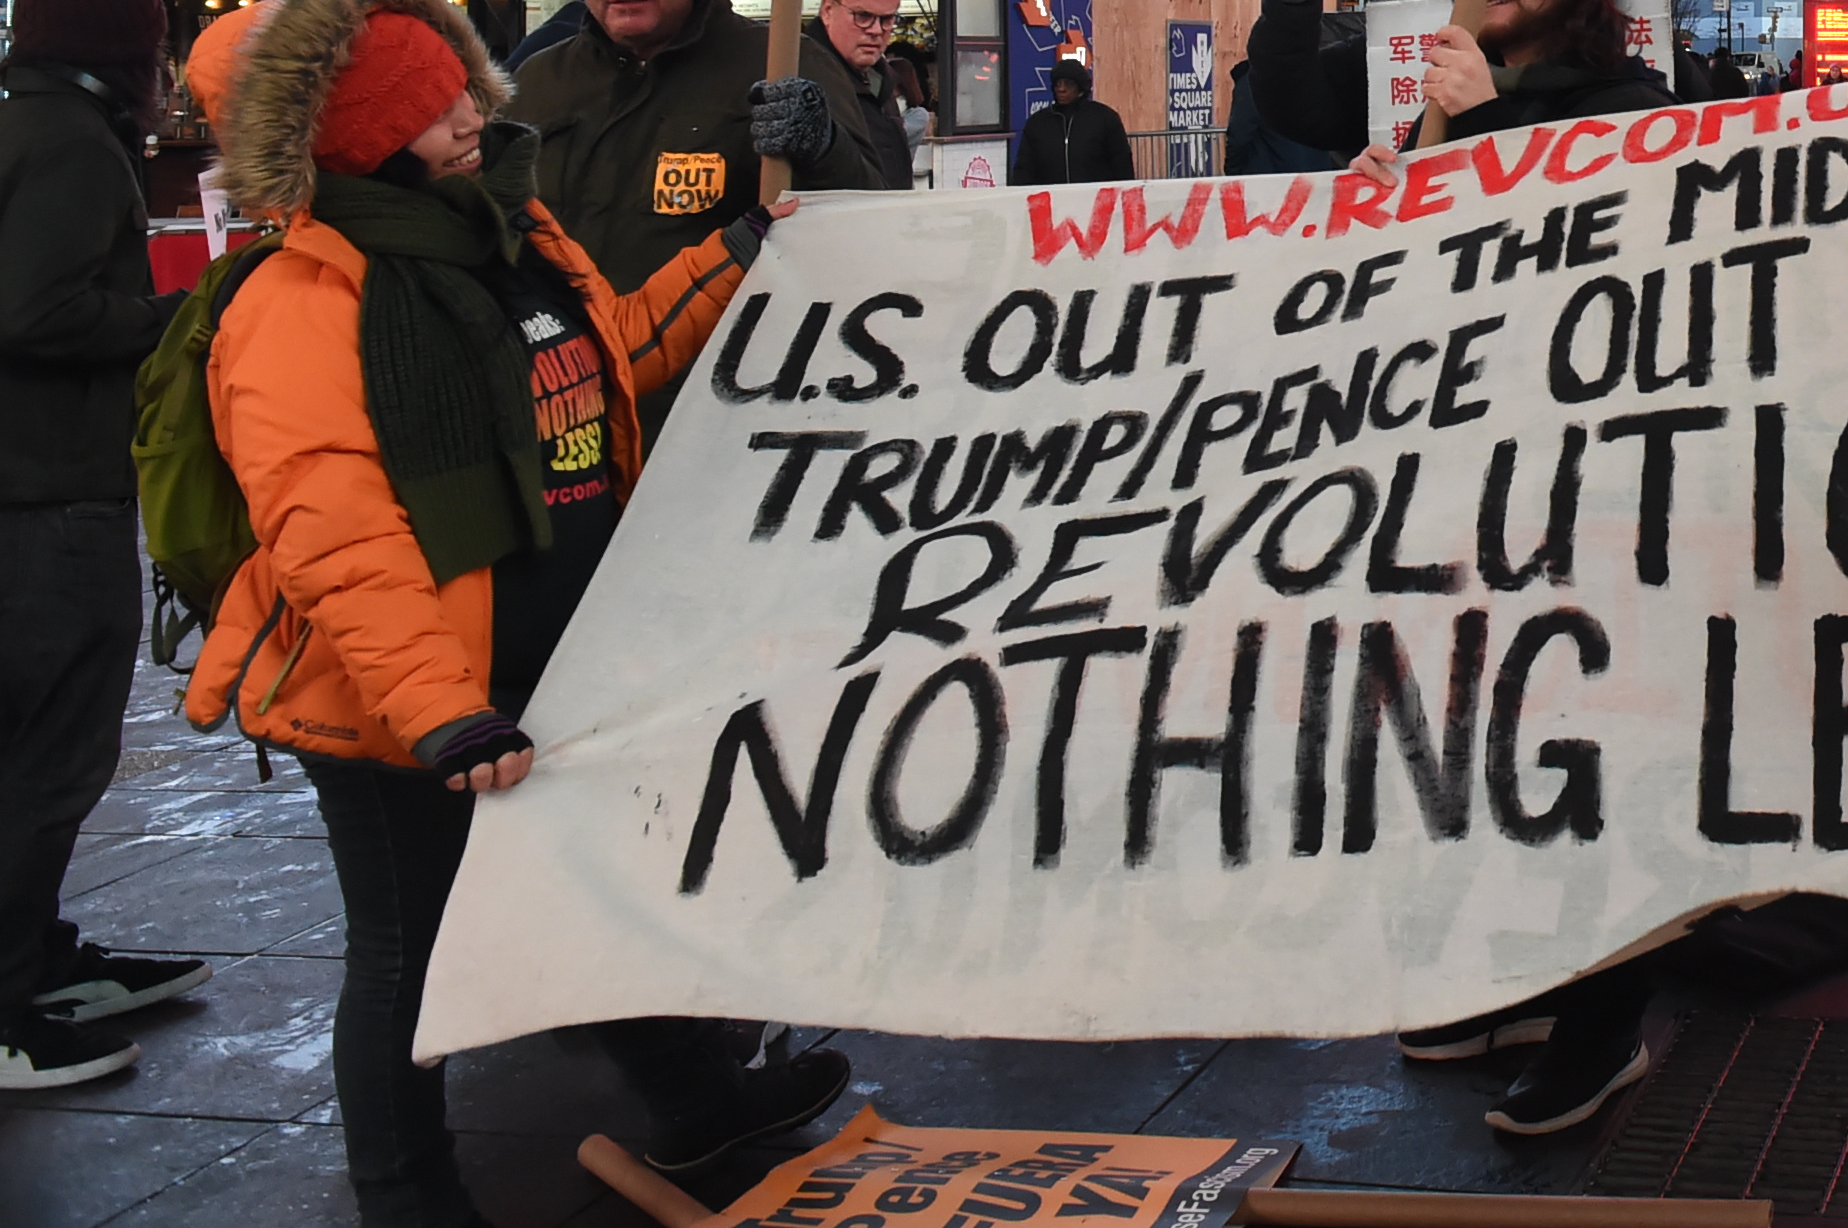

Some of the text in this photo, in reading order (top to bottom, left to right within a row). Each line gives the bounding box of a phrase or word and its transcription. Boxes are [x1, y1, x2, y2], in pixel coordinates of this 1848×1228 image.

[1169, 72, 1198, 90] TIMES
[1174, 90, 1213, 108] SQUARE
[1169, 109, 1210, 128] MARKET
[662, 167, 716, 188] OUT
[656, 188, 720, 210] NOW
[711, 290, 924, 405] U.S.
[961, 272, 1237, 394] OUT
[1274, 249, 1408, 337] OF
[1438, 190, 1628, 294] THE
[747, 312, 1507, 544] TRUMP/PENCE
[1546, 237, 1811, 404] OUT
[677, 605, 1613, 896] NOTHING
[1053, 1168, 1176, 1221] YA!
